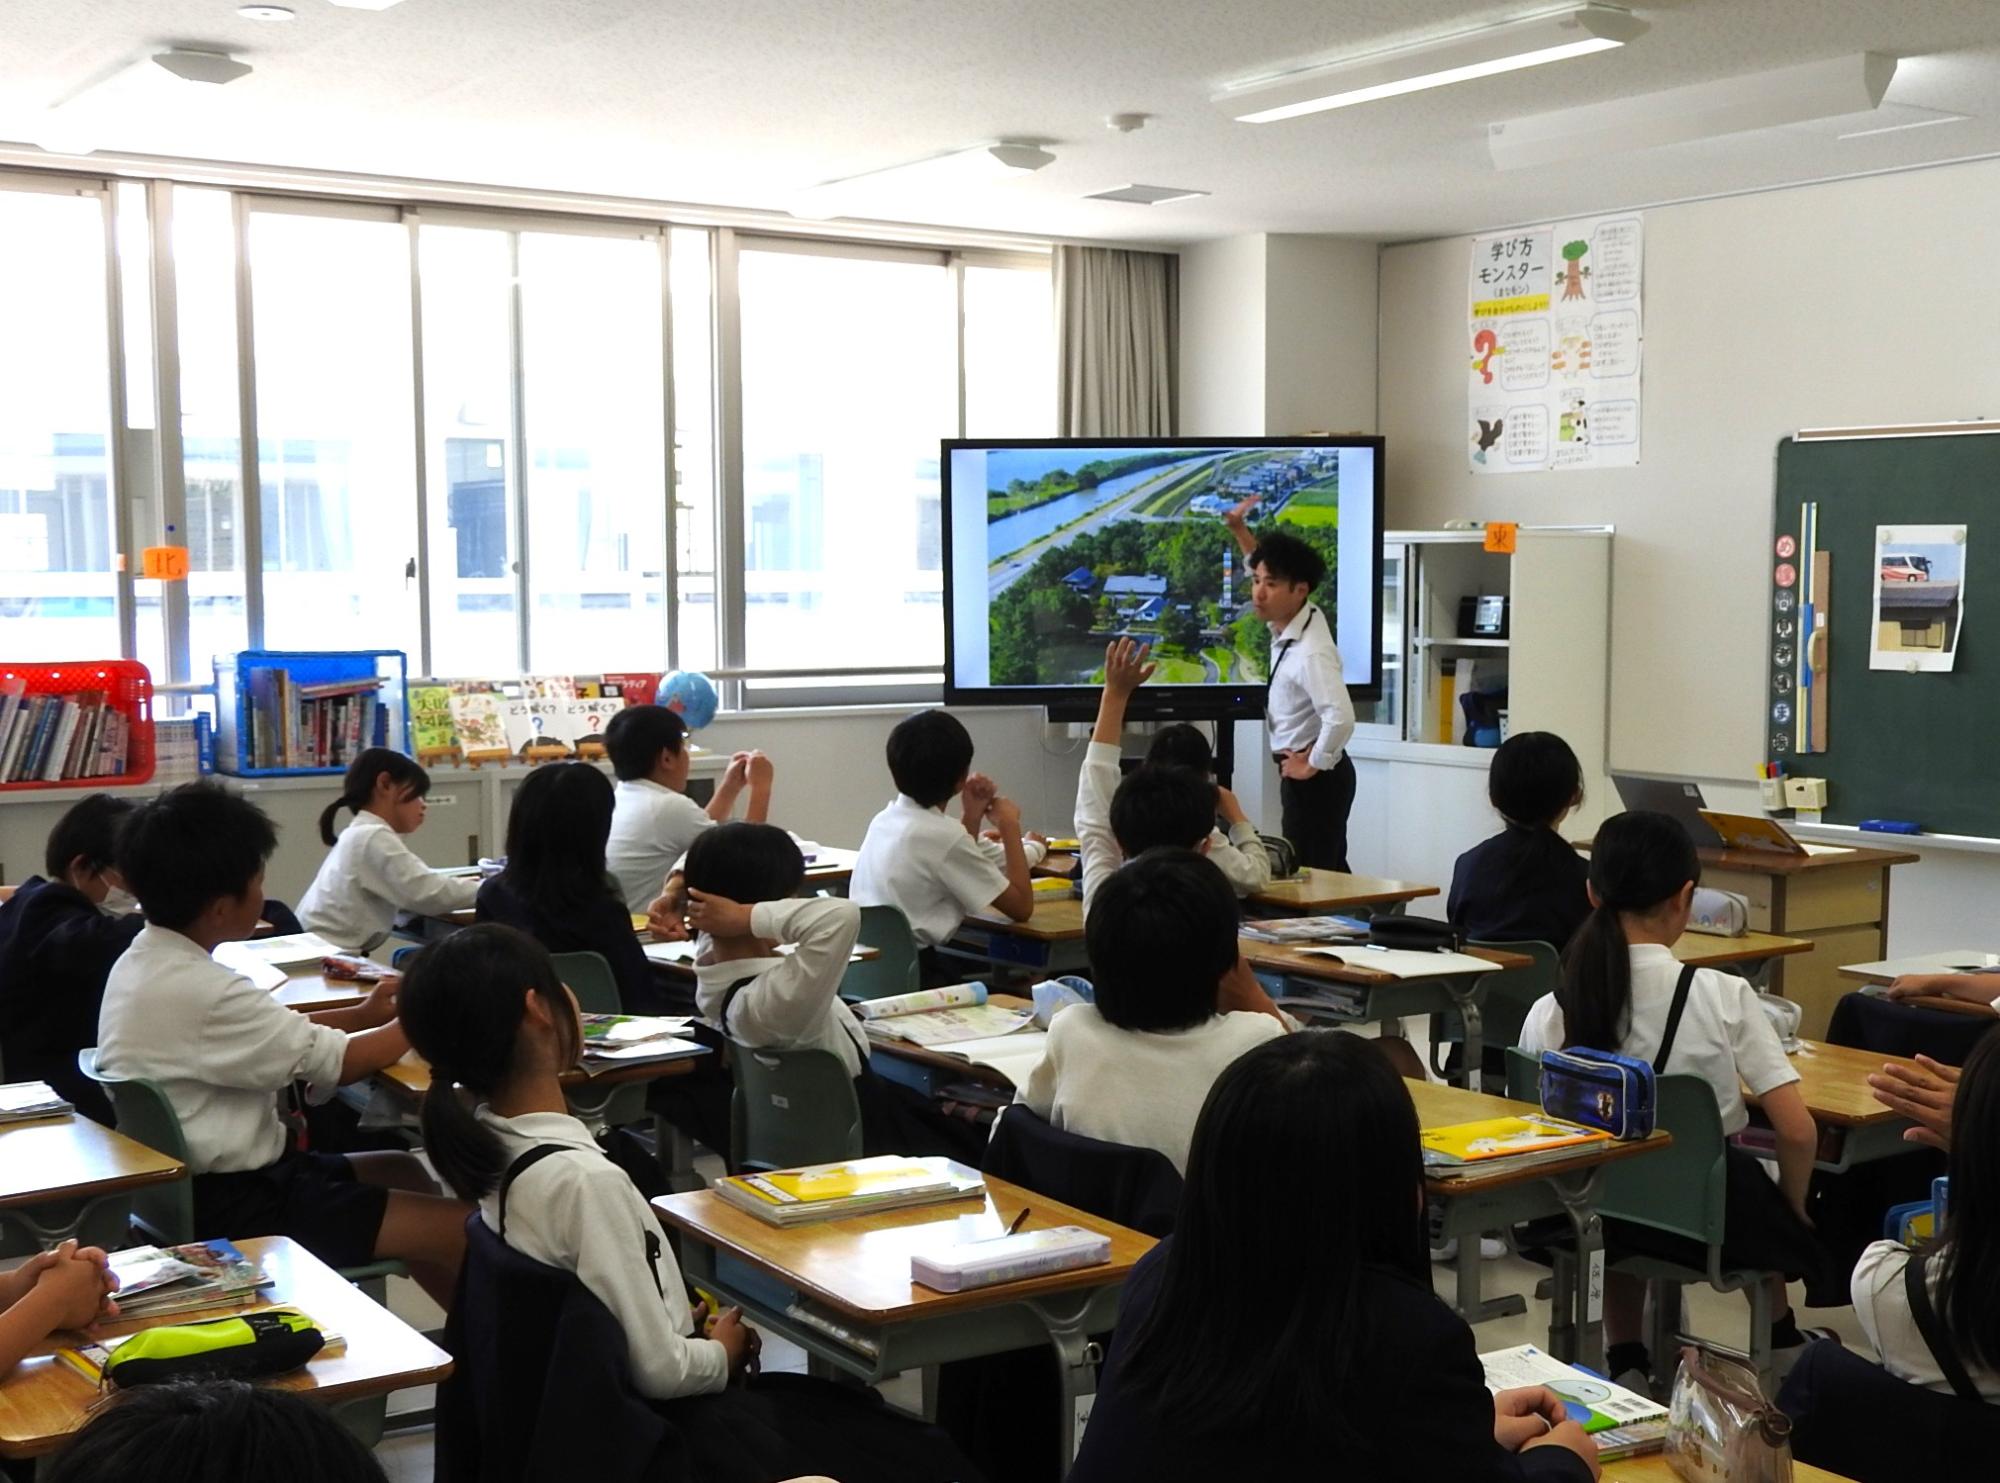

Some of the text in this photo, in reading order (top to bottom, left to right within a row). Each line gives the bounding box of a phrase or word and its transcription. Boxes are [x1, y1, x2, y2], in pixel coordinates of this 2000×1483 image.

[1491, 237, 1533, 261] 学び方
[1479, 262, 1544, 284] モンスター
